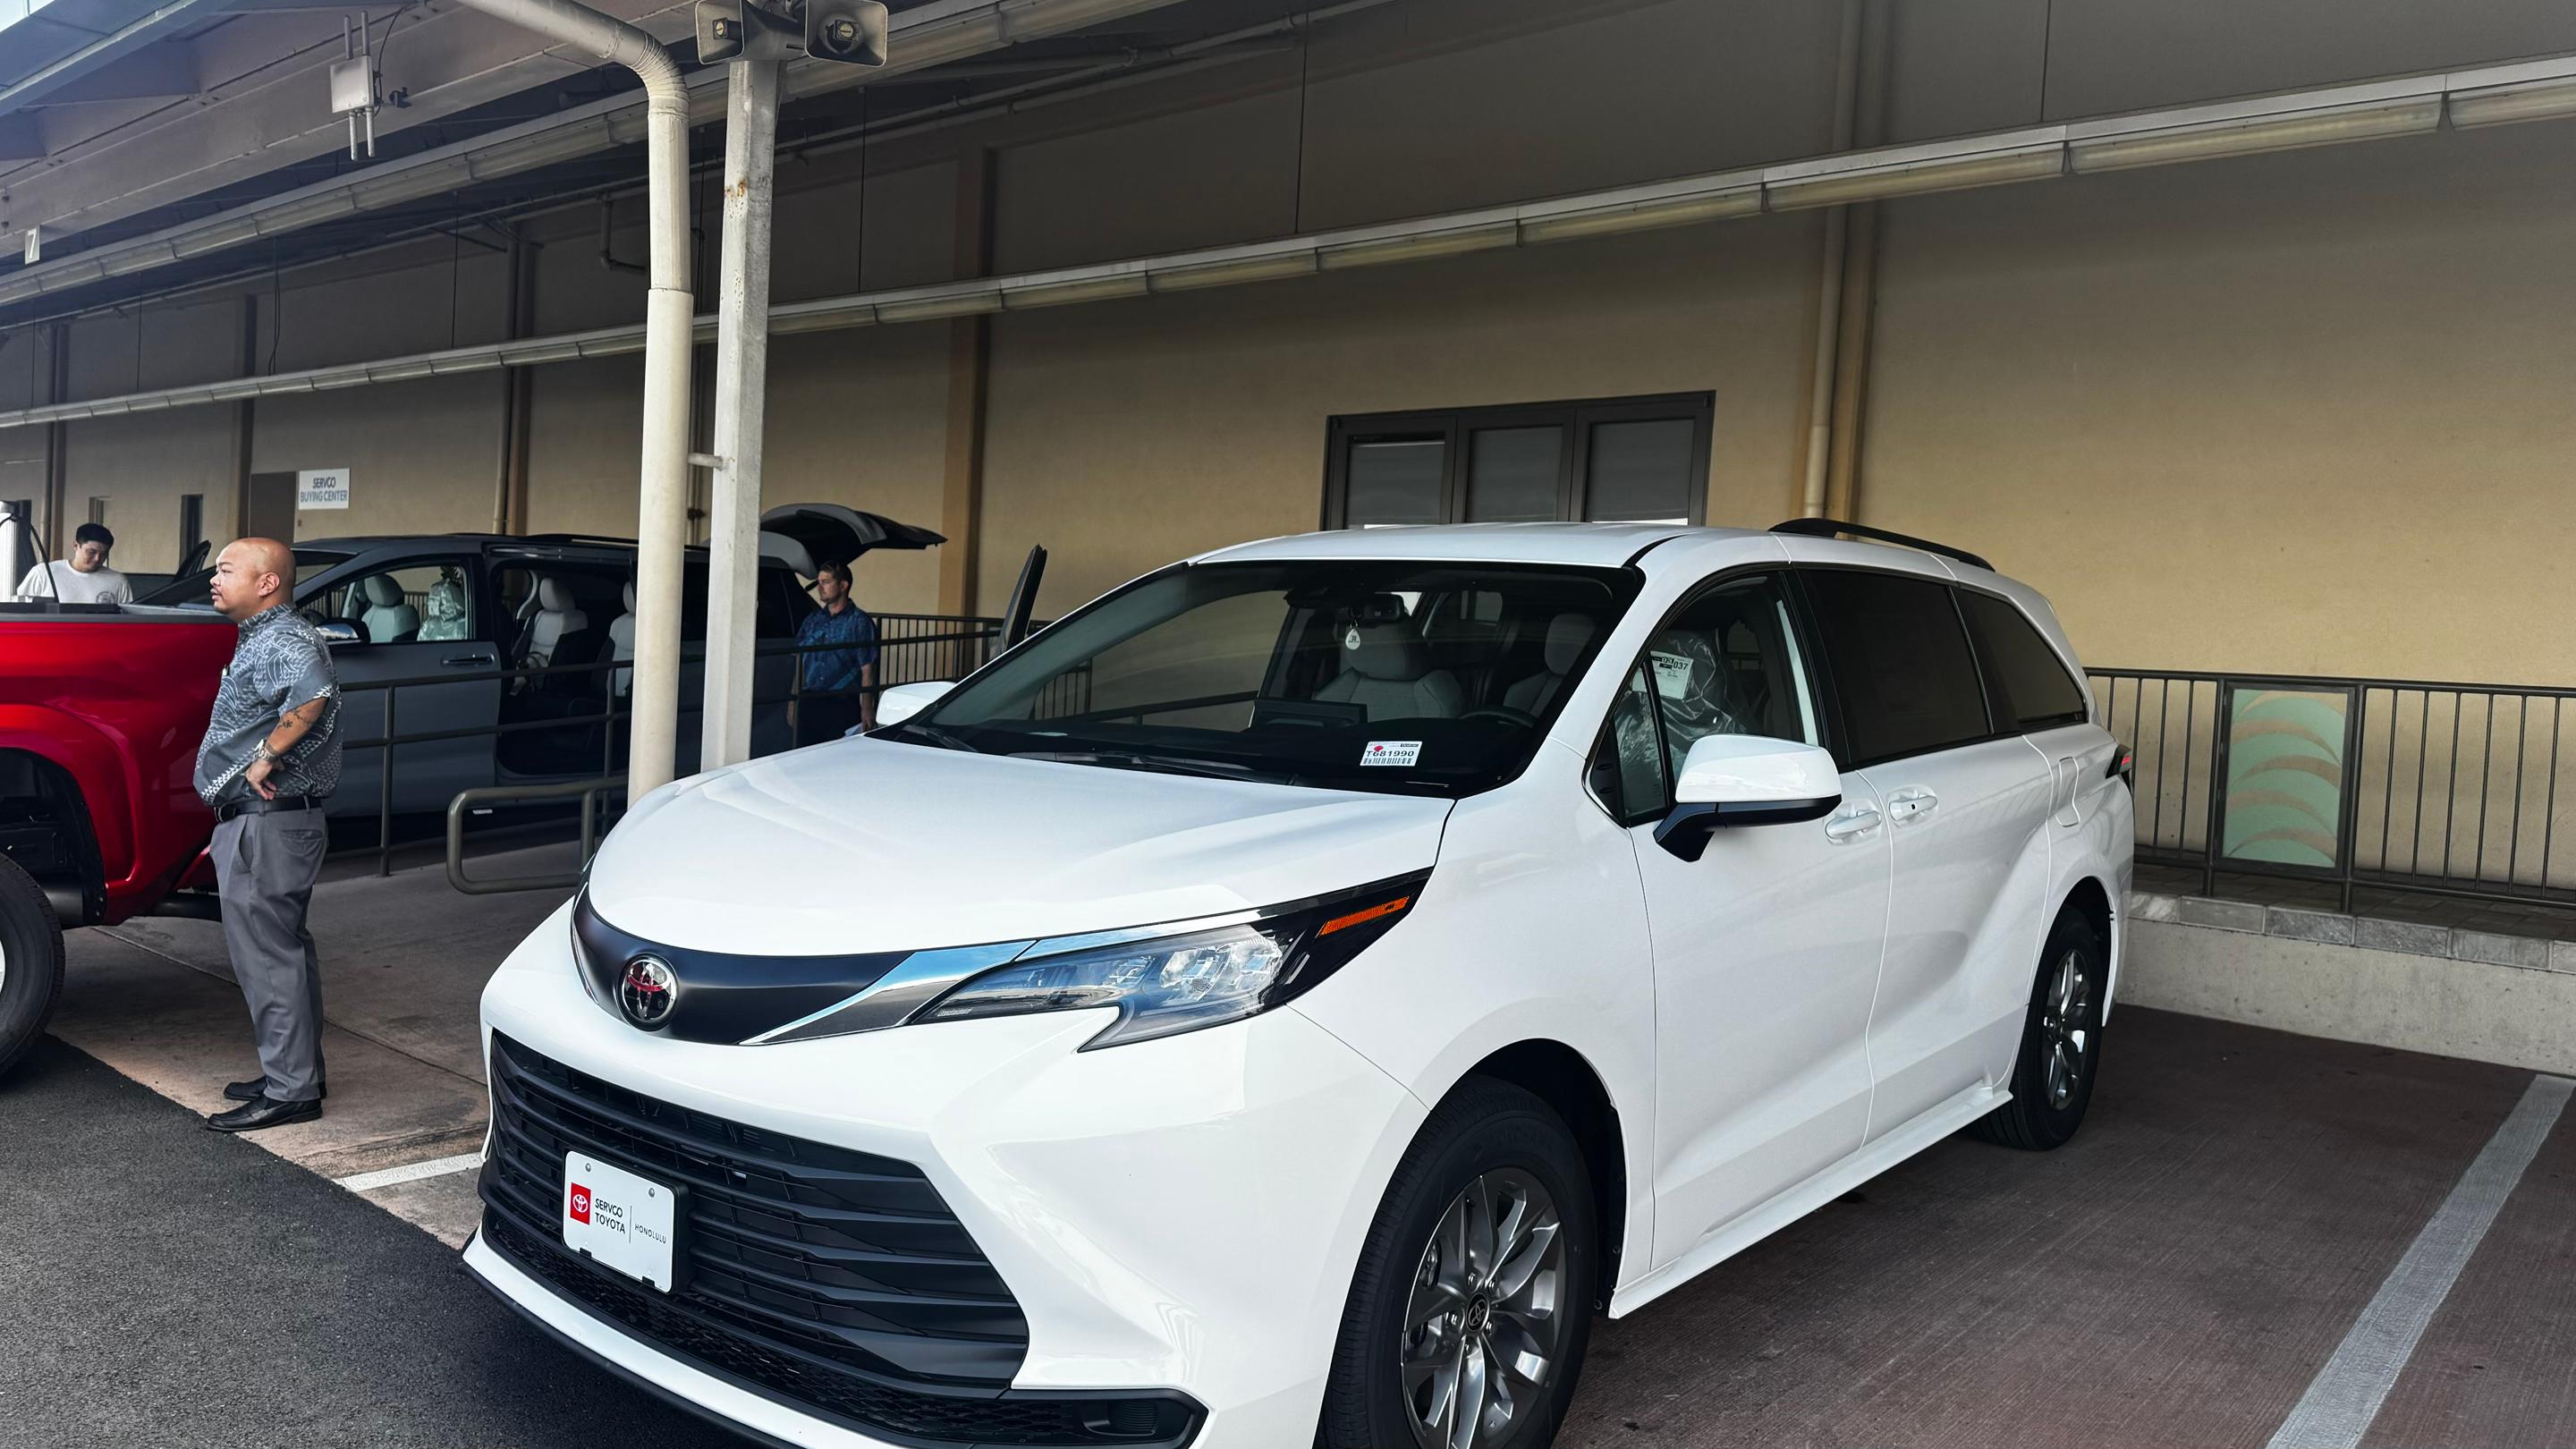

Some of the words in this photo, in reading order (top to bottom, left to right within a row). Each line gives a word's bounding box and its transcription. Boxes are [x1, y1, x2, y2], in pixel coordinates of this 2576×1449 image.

[28, 228, 37, 258] 7
[313, 477, 336, 489] SERVCO
[301, 491, 323, 503] BUYING
[324, 490, 348, 501] CENTER
[1673, 661, 1689, 671] 037
[595, 1198, 624, 1217] SERVCO
[595, 1212, 626, 1234] TOYOTA
[634, 1224, 666, 1244] HONOLULU
